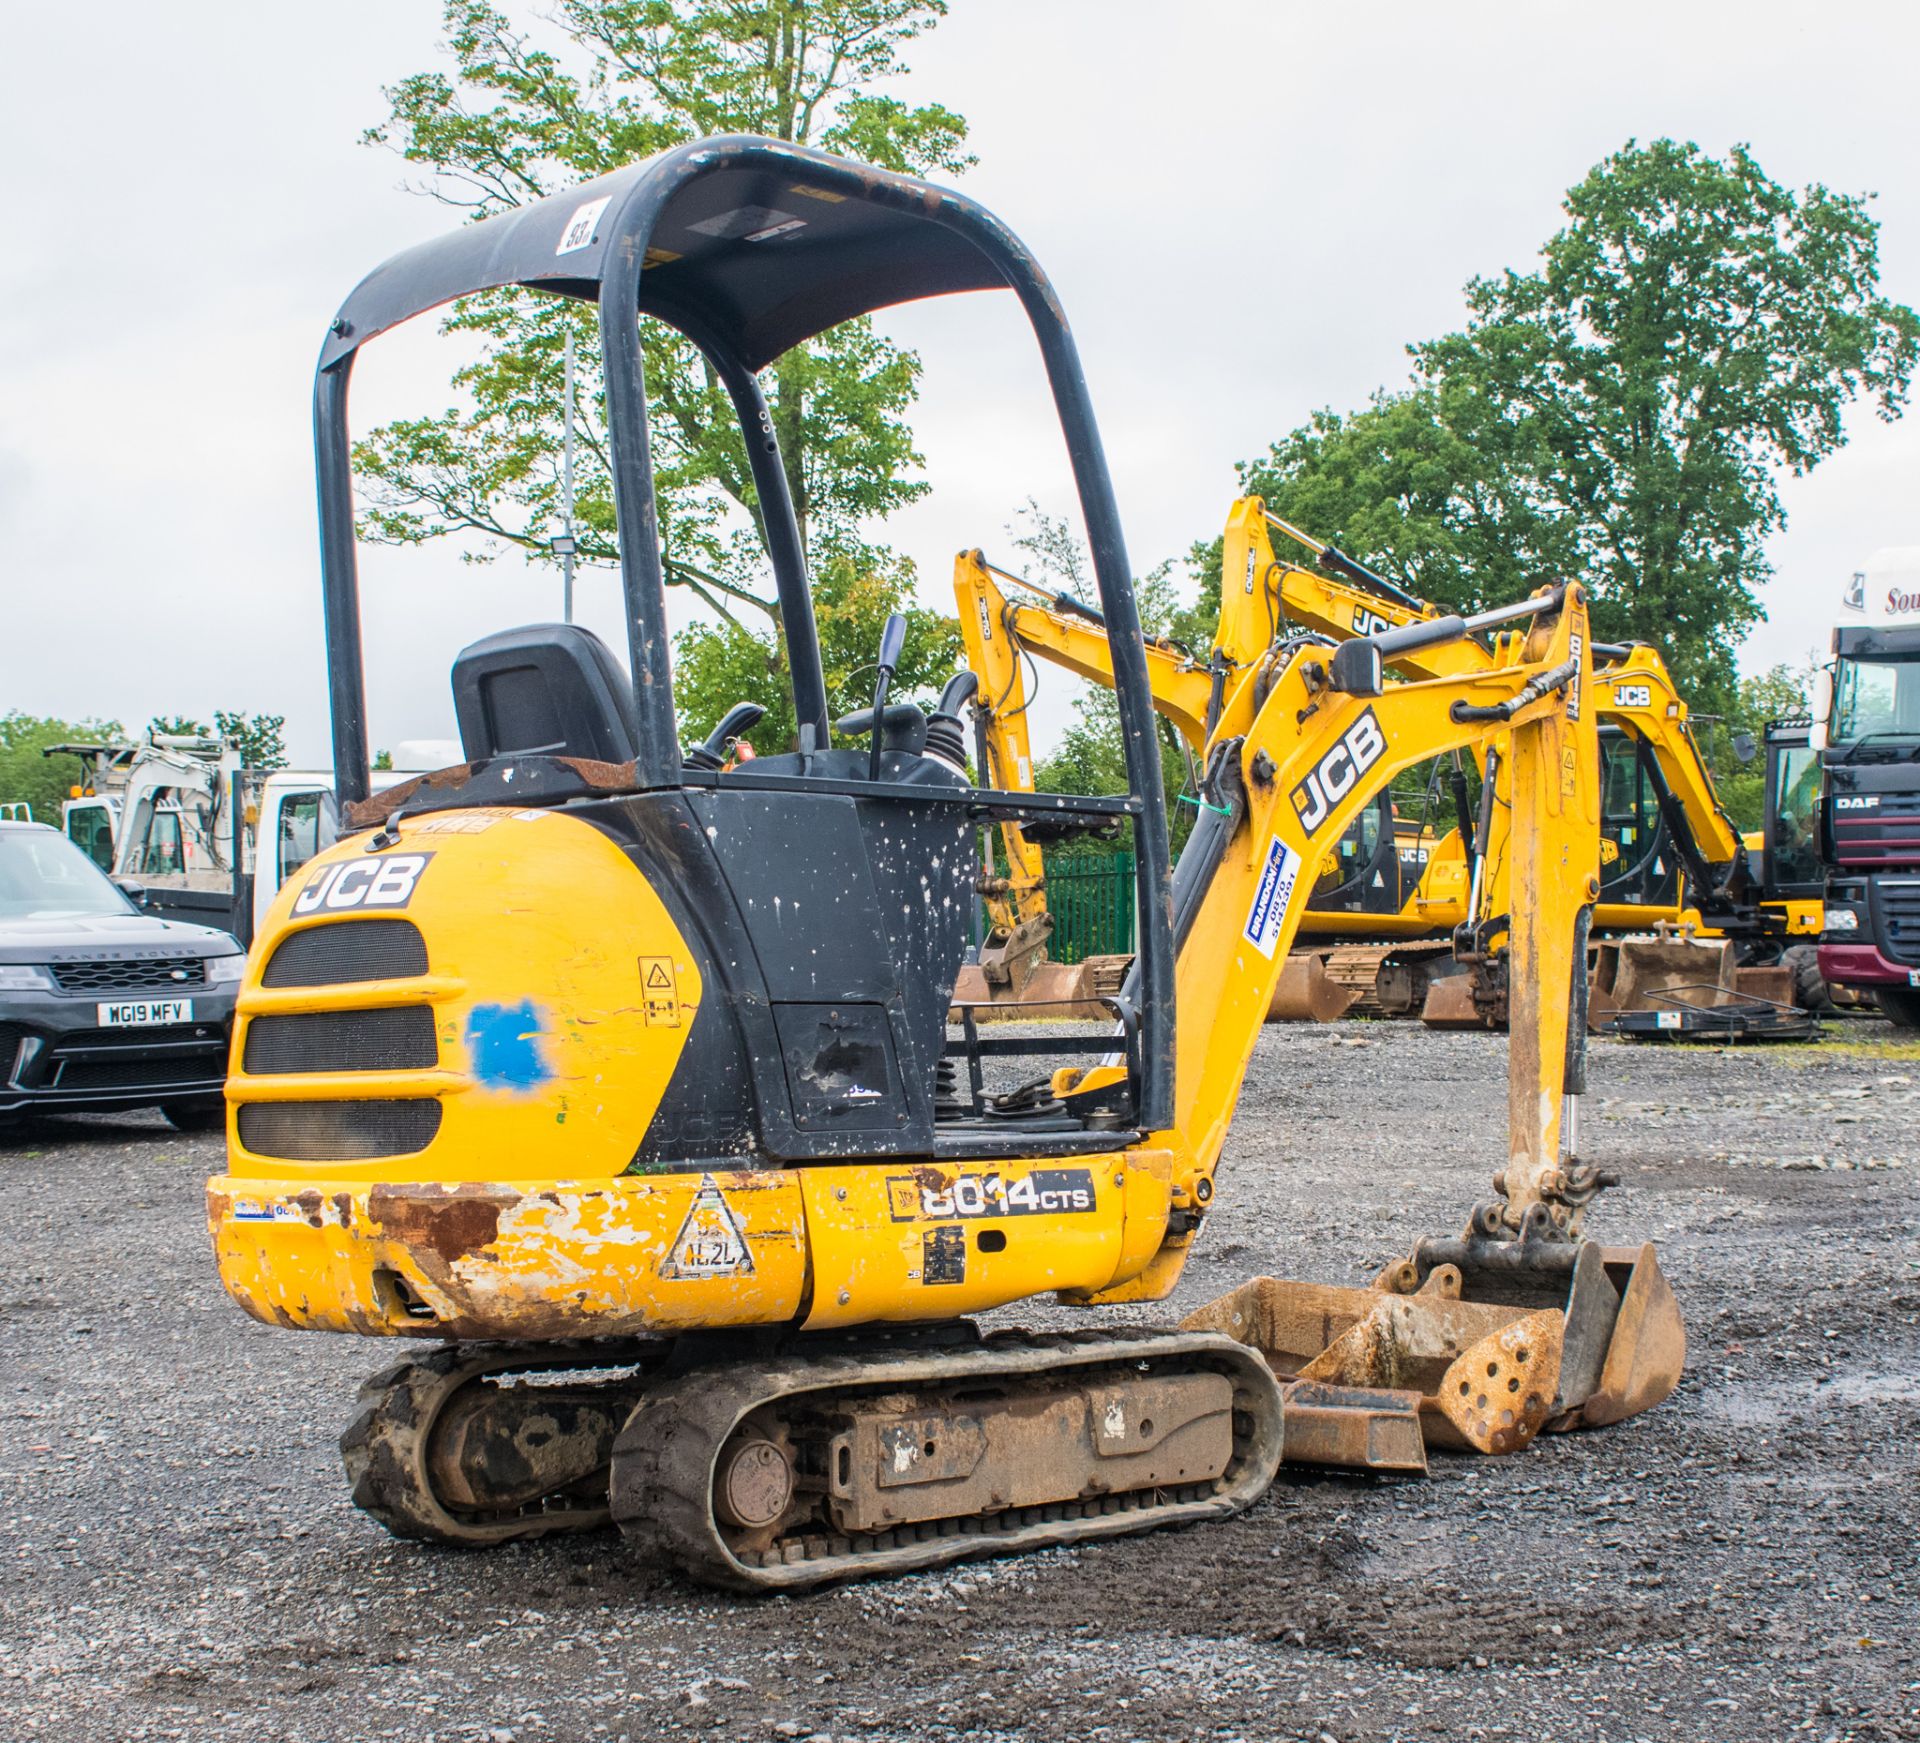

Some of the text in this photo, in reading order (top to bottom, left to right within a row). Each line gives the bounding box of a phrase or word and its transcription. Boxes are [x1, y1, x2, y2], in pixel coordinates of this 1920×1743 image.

[1353, 610, 1398, 637] JC
[1614, 686, 1650, 706] JCB
[1300, 713, 1384, 831] JCB
[1836, 797, 1879, 809] DAF
[1400, 850, 1428, 863] JCB
[294, 856, 426, 913] JCB
[1270, 880, 1286, 922] 0870
[51, 949, 197, 961] RANGE ROVER
[109, 1003, 182, 1023] WG19 MFV
[922, 1175, 1090, 1216] 8014 CTS
